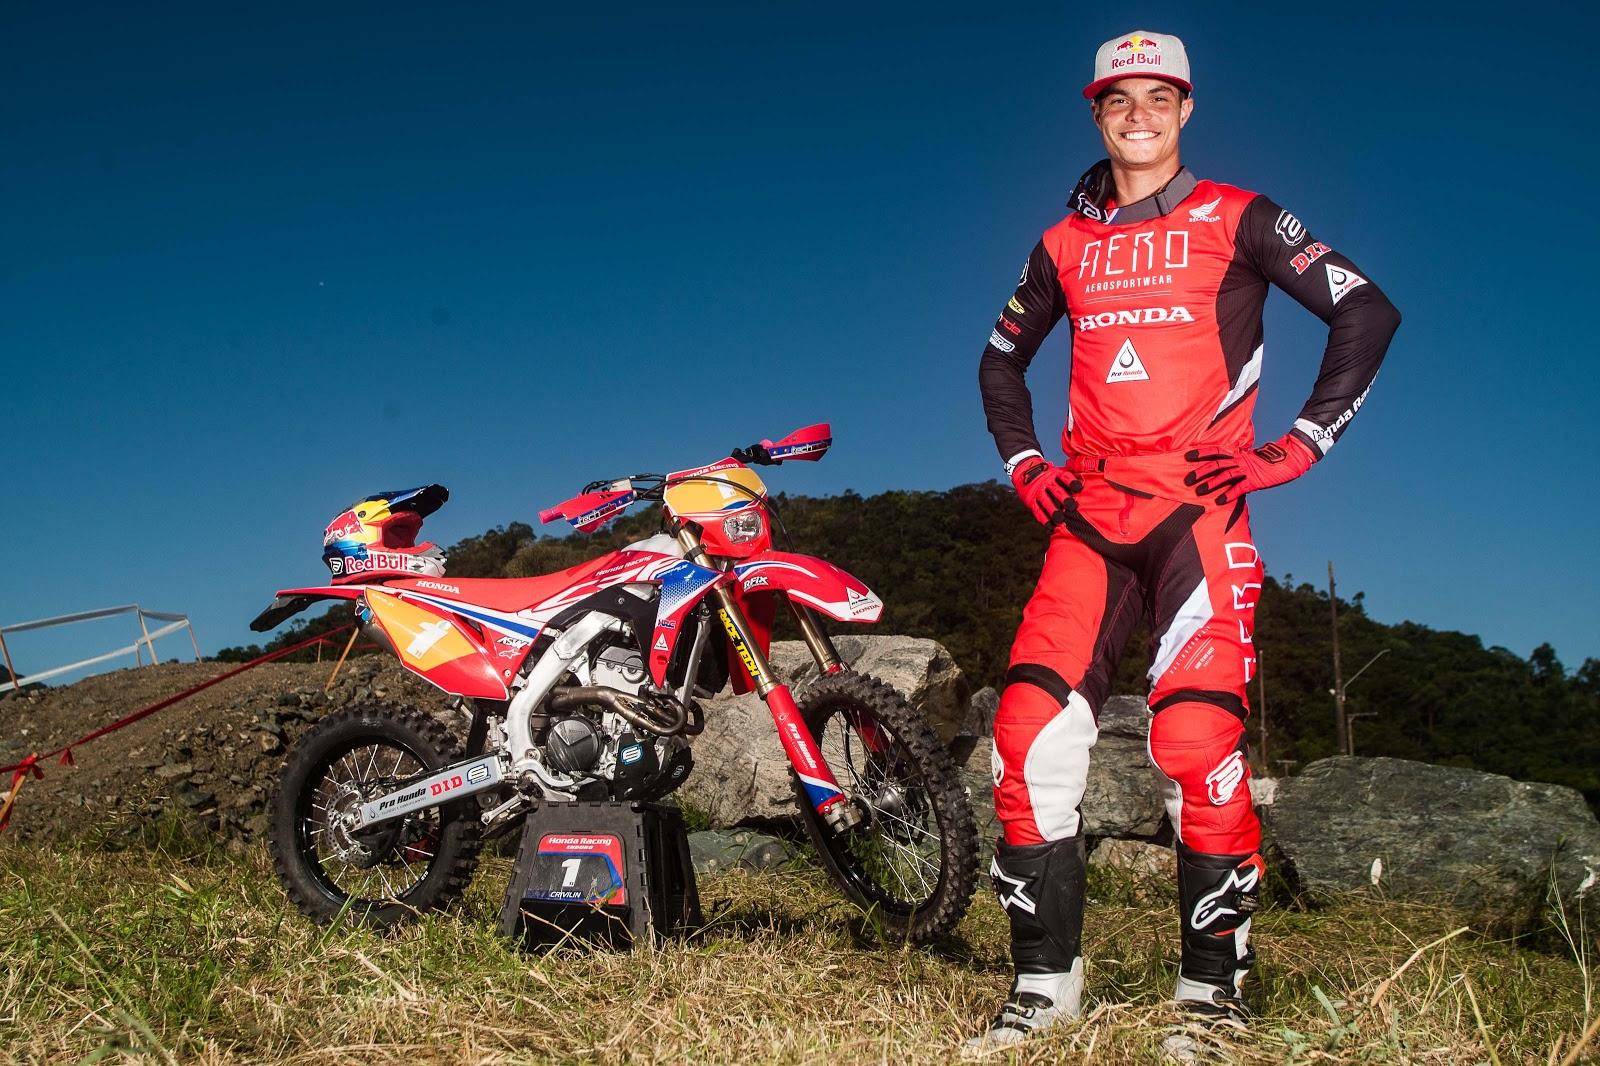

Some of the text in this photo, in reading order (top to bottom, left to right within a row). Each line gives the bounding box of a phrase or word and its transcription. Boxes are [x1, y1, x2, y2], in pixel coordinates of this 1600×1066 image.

[1112, 53, 1161, 69] Red Bull
[1188, 215, 1221, 223] HONDA
[1078, 231, 1189, 280] AERO
[1085, 275, 1172, 293] AEROSPORTWEAR
[1077, 306, 1195, 332] HONDA
[1313, 408, 1353, 442] Honda
[710, 463, 739, 474] Racing
[345, 554, 408, 573] Red Bull
[415, 580, 461, 594] HONDA
[787, 723, 801, 739] Pro
[379, 799, 396, 811] Pro
[397, 788, 426, 804] Honda
[580, 837, 612, 846] Racing
[561, 858, 582, 887] 1
